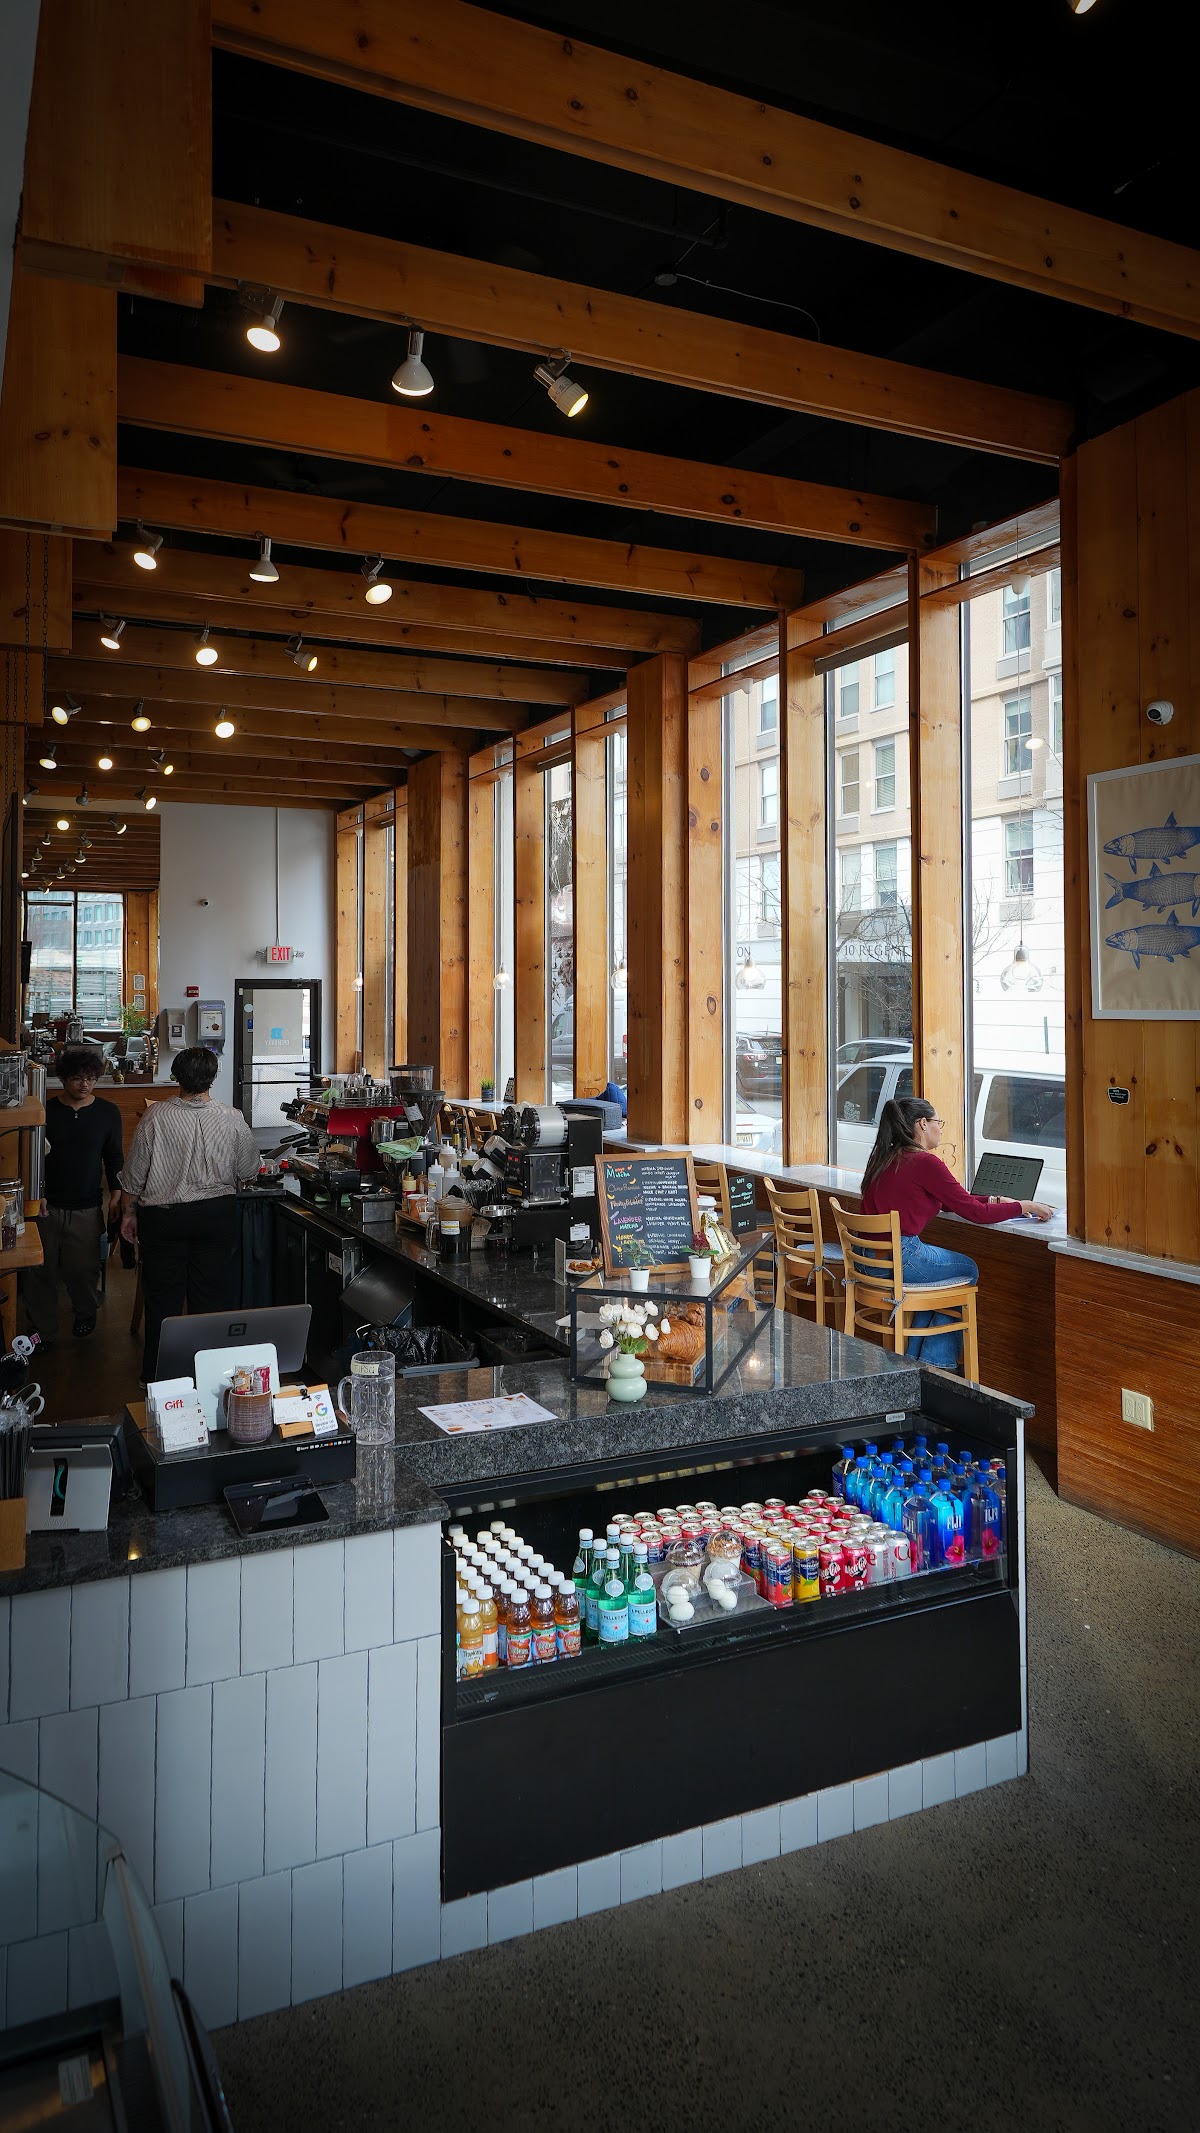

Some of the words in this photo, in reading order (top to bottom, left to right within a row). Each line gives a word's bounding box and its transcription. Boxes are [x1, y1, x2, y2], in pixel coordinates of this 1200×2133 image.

[271, 947, 290, 960] EXIT
[844, 944, 855, 956] 10
[859, 944, 908, 956] REGENT
[613, 1216, 642, 1225] LAVENDER
[164, 1399, 184, 1410] Gift
[315, 1403, 328, 1416] G
[947, 1514, 962, 1530] FIJI
